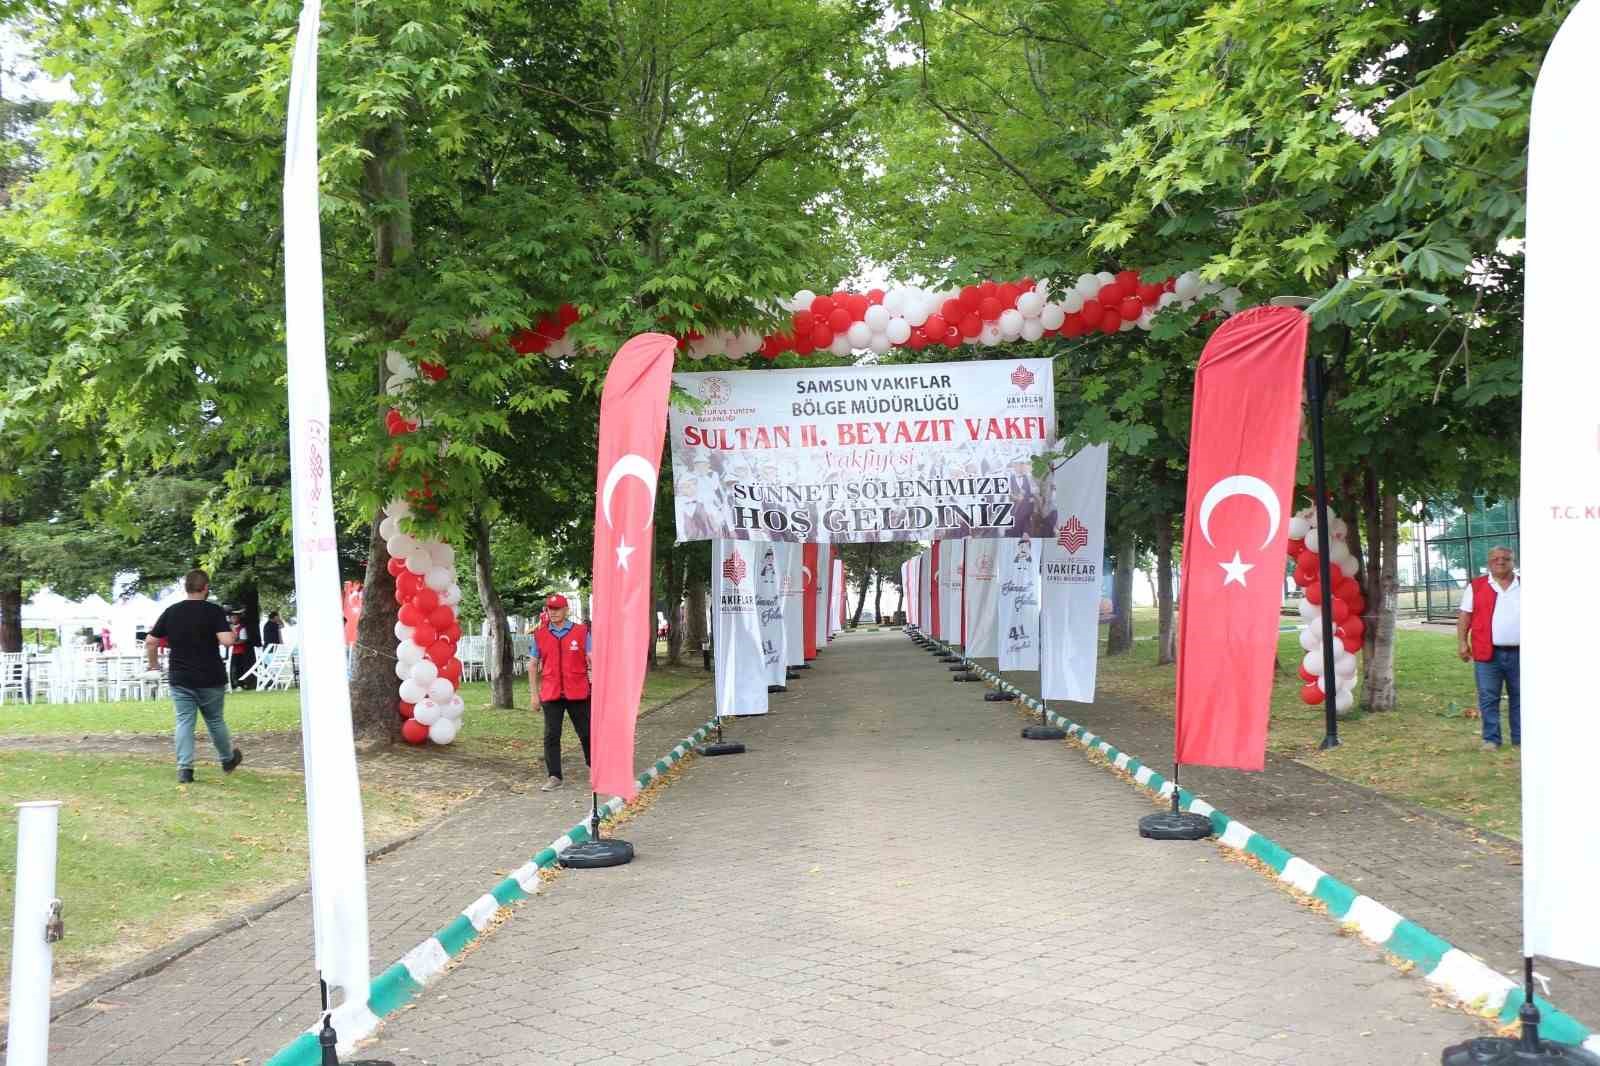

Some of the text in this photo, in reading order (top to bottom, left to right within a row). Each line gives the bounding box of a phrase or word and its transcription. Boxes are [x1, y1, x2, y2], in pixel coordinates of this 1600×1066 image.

[796, 375, 951, 394] SAMSUN VAKIFLAR
[792, 393, 959, 416] BÖLGE MÜDÜRLÜĞÜ
[684, 416, 1046, 450] SULTAN II. BEYAZIT VAKFI
[734, 475, 1009, 504] SÜNNET ŞÖLENİMİZE
[735, 499, 1014, 537] HOŞ GELDİNİZ
[1550, 506, 1600, 519] T.C. K
[1047, 563, 1096, 575] VAKIFLAR
